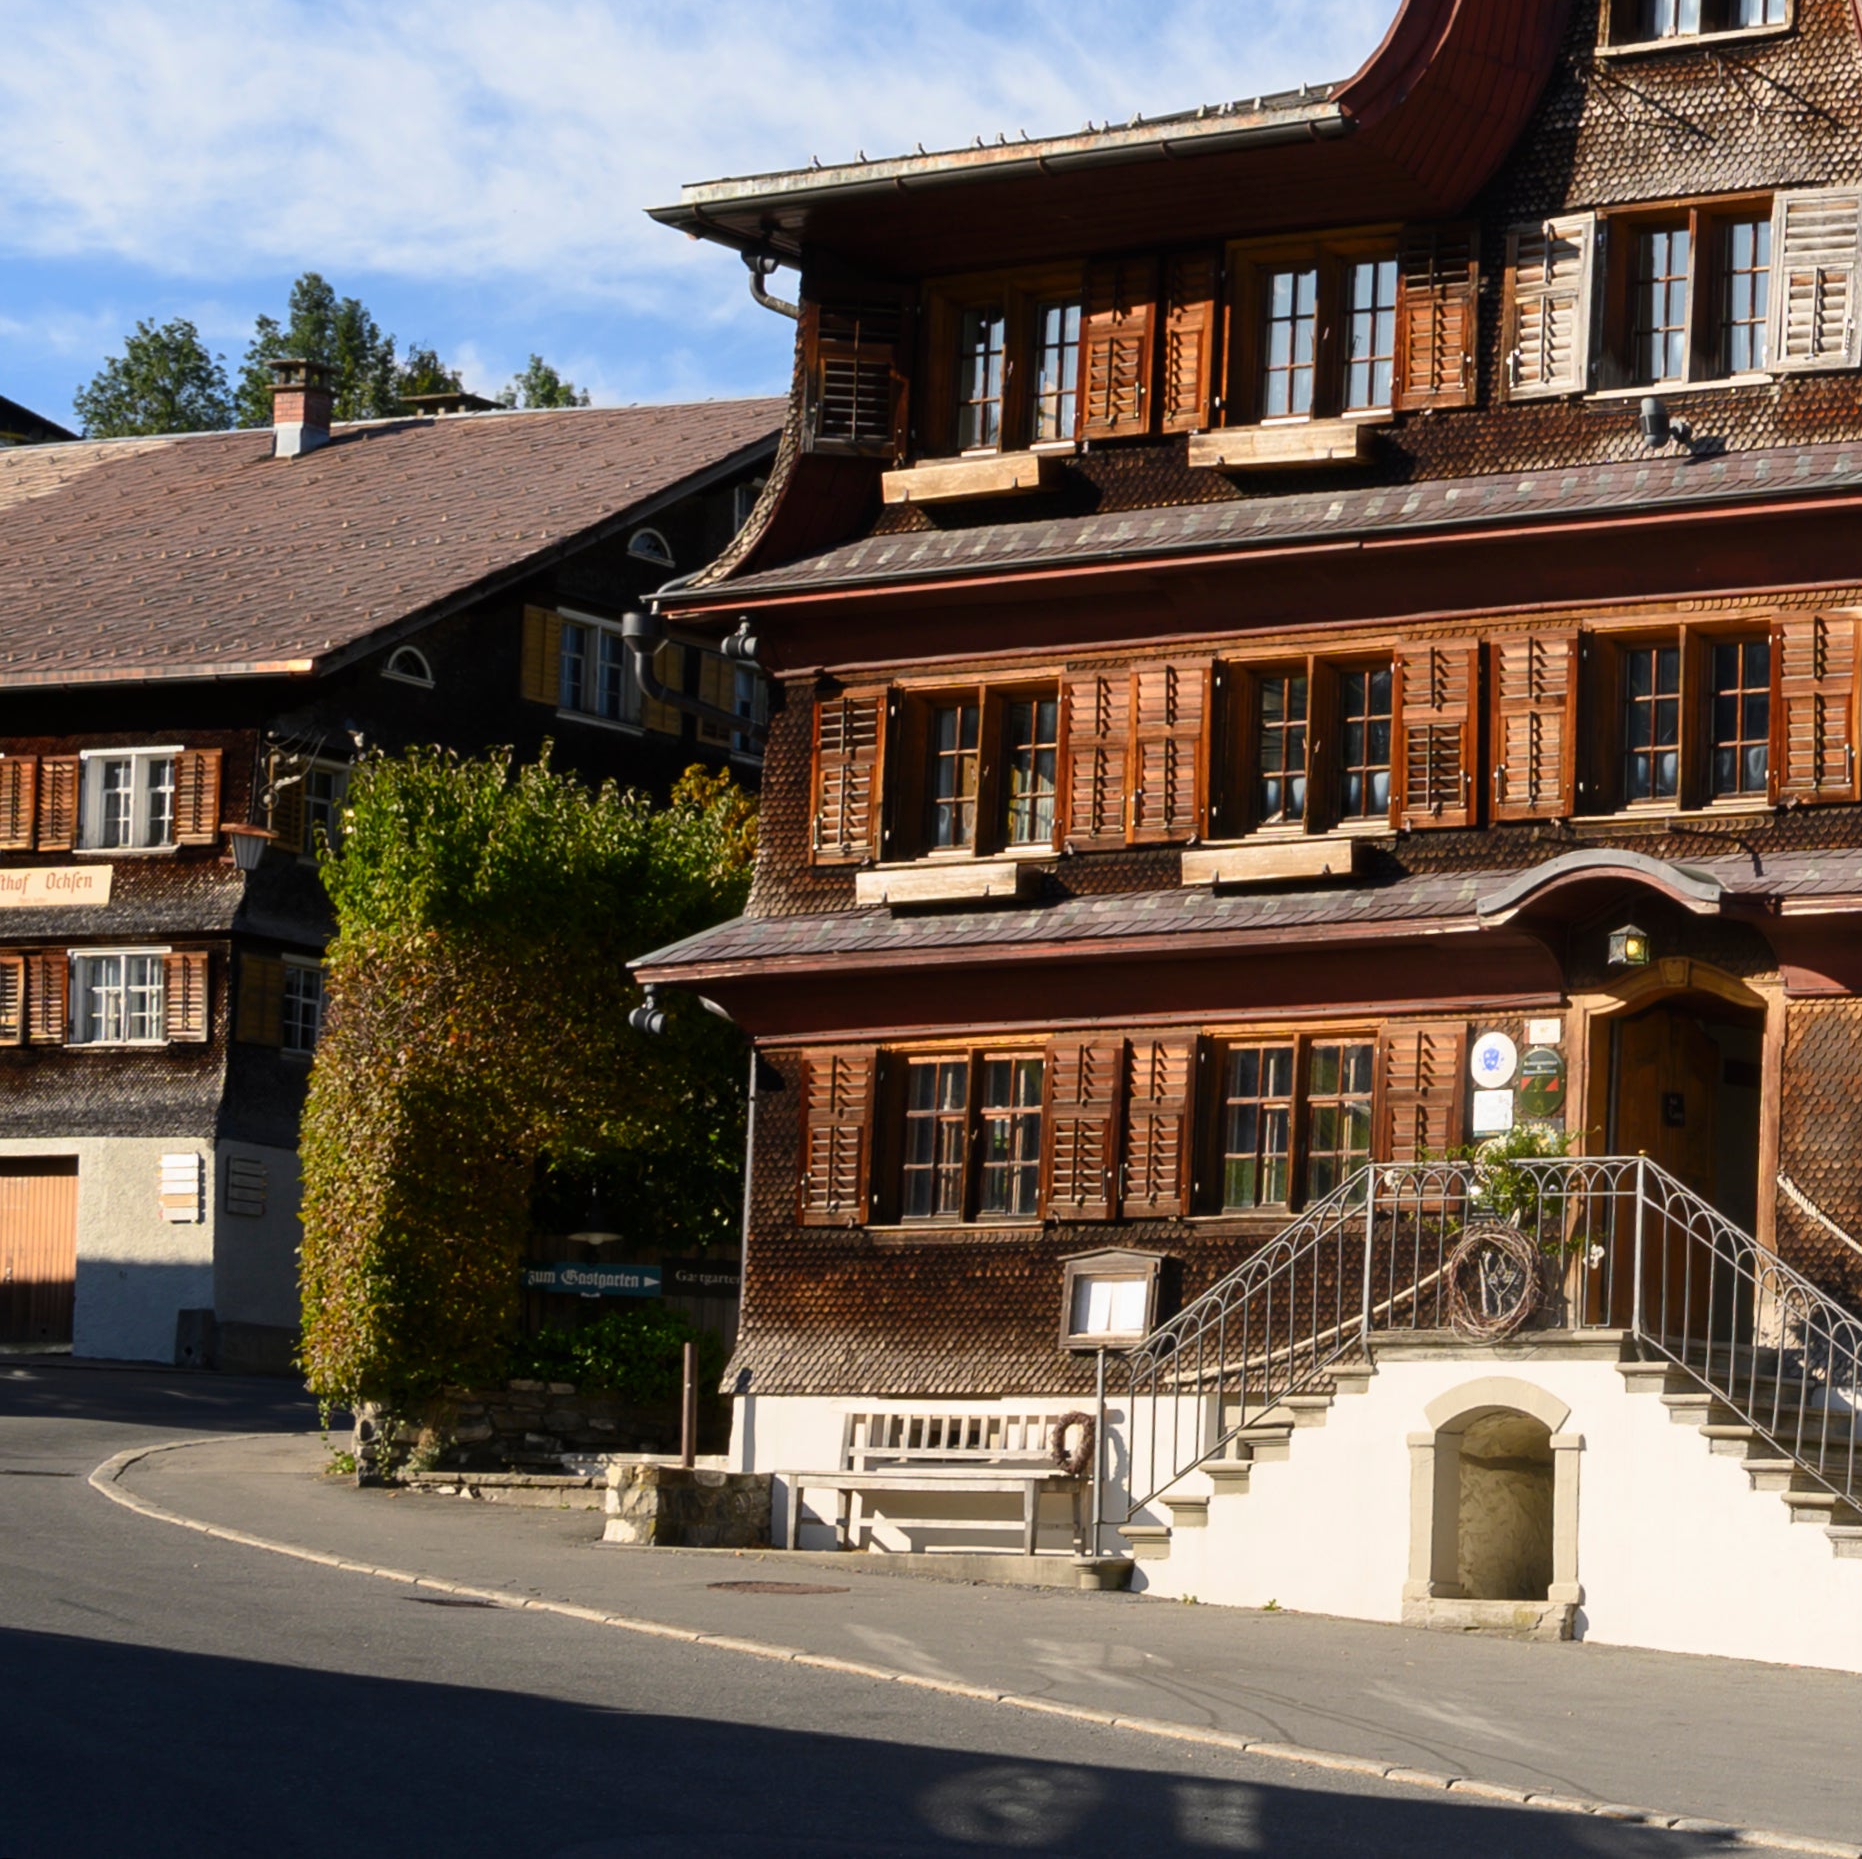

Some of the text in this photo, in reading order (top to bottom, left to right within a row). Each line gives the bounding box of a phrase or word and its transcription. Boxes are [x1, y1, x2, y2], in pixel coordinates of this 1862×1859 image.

[0, 873, 31, 895] thof
[528, 1268, 640, 1289] zum Gastgarten
